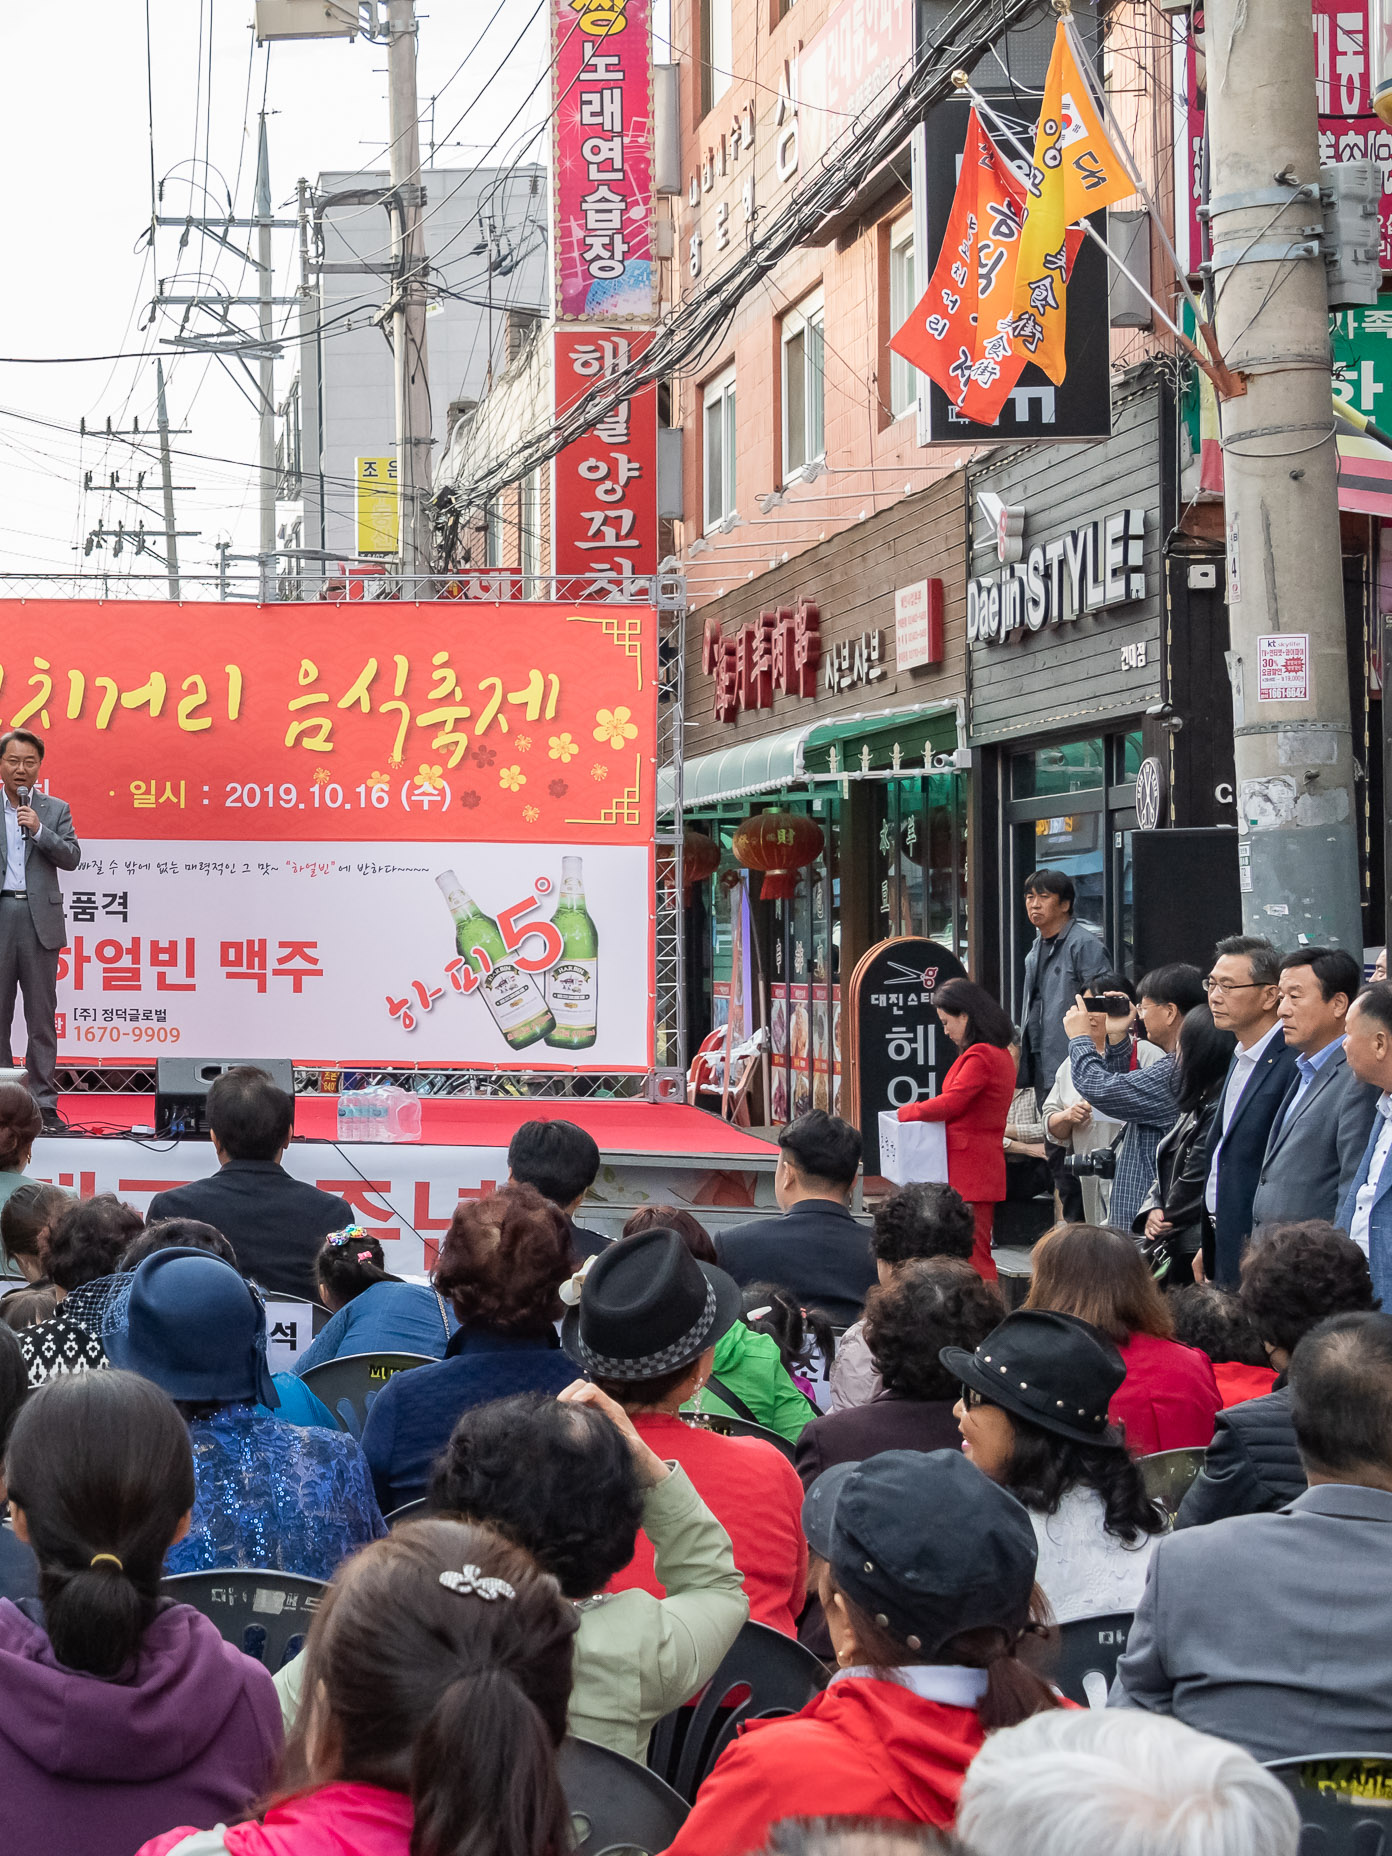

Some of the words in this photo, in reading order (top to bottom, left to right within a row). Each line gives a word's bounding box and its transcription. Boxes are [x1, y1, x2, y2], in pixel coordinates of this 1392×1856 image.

[578, 42, 626, 281] 노래연습장
[1120, 641, 1149, 672] 건대점
[1267, 640, 1277, 648] kt
[824, 628, 884, 694] 샤브샤브
[1262, 658, 1279, 668] 30%
[283, 650, 561, 770] 음식축제
[128, 779, 187, 809] 일시
[224, 781, 389, 810] 2019.10.16
[400, 779, 452, 812] (수)
[108, 859, 119, 876] 수
[124, 859, 152, 876] 밖에
[156, 860, 180, 875] 없는
[184, 860, 237, 876] 매력적인
[241, 862, 252, 874] 그
[63, 890, 130, 924] 품격
[55, 935, 197, 993] 하얼빈
[219, 937, 325, 994] 맥주
[557, 964, 585, 976] HARBIN
[101, 1007, 168, 1023] 정덕글로벌
[870, 992, 935, 1016] 대진스타
[73, 1025, 182, 1044] 1670-9909
